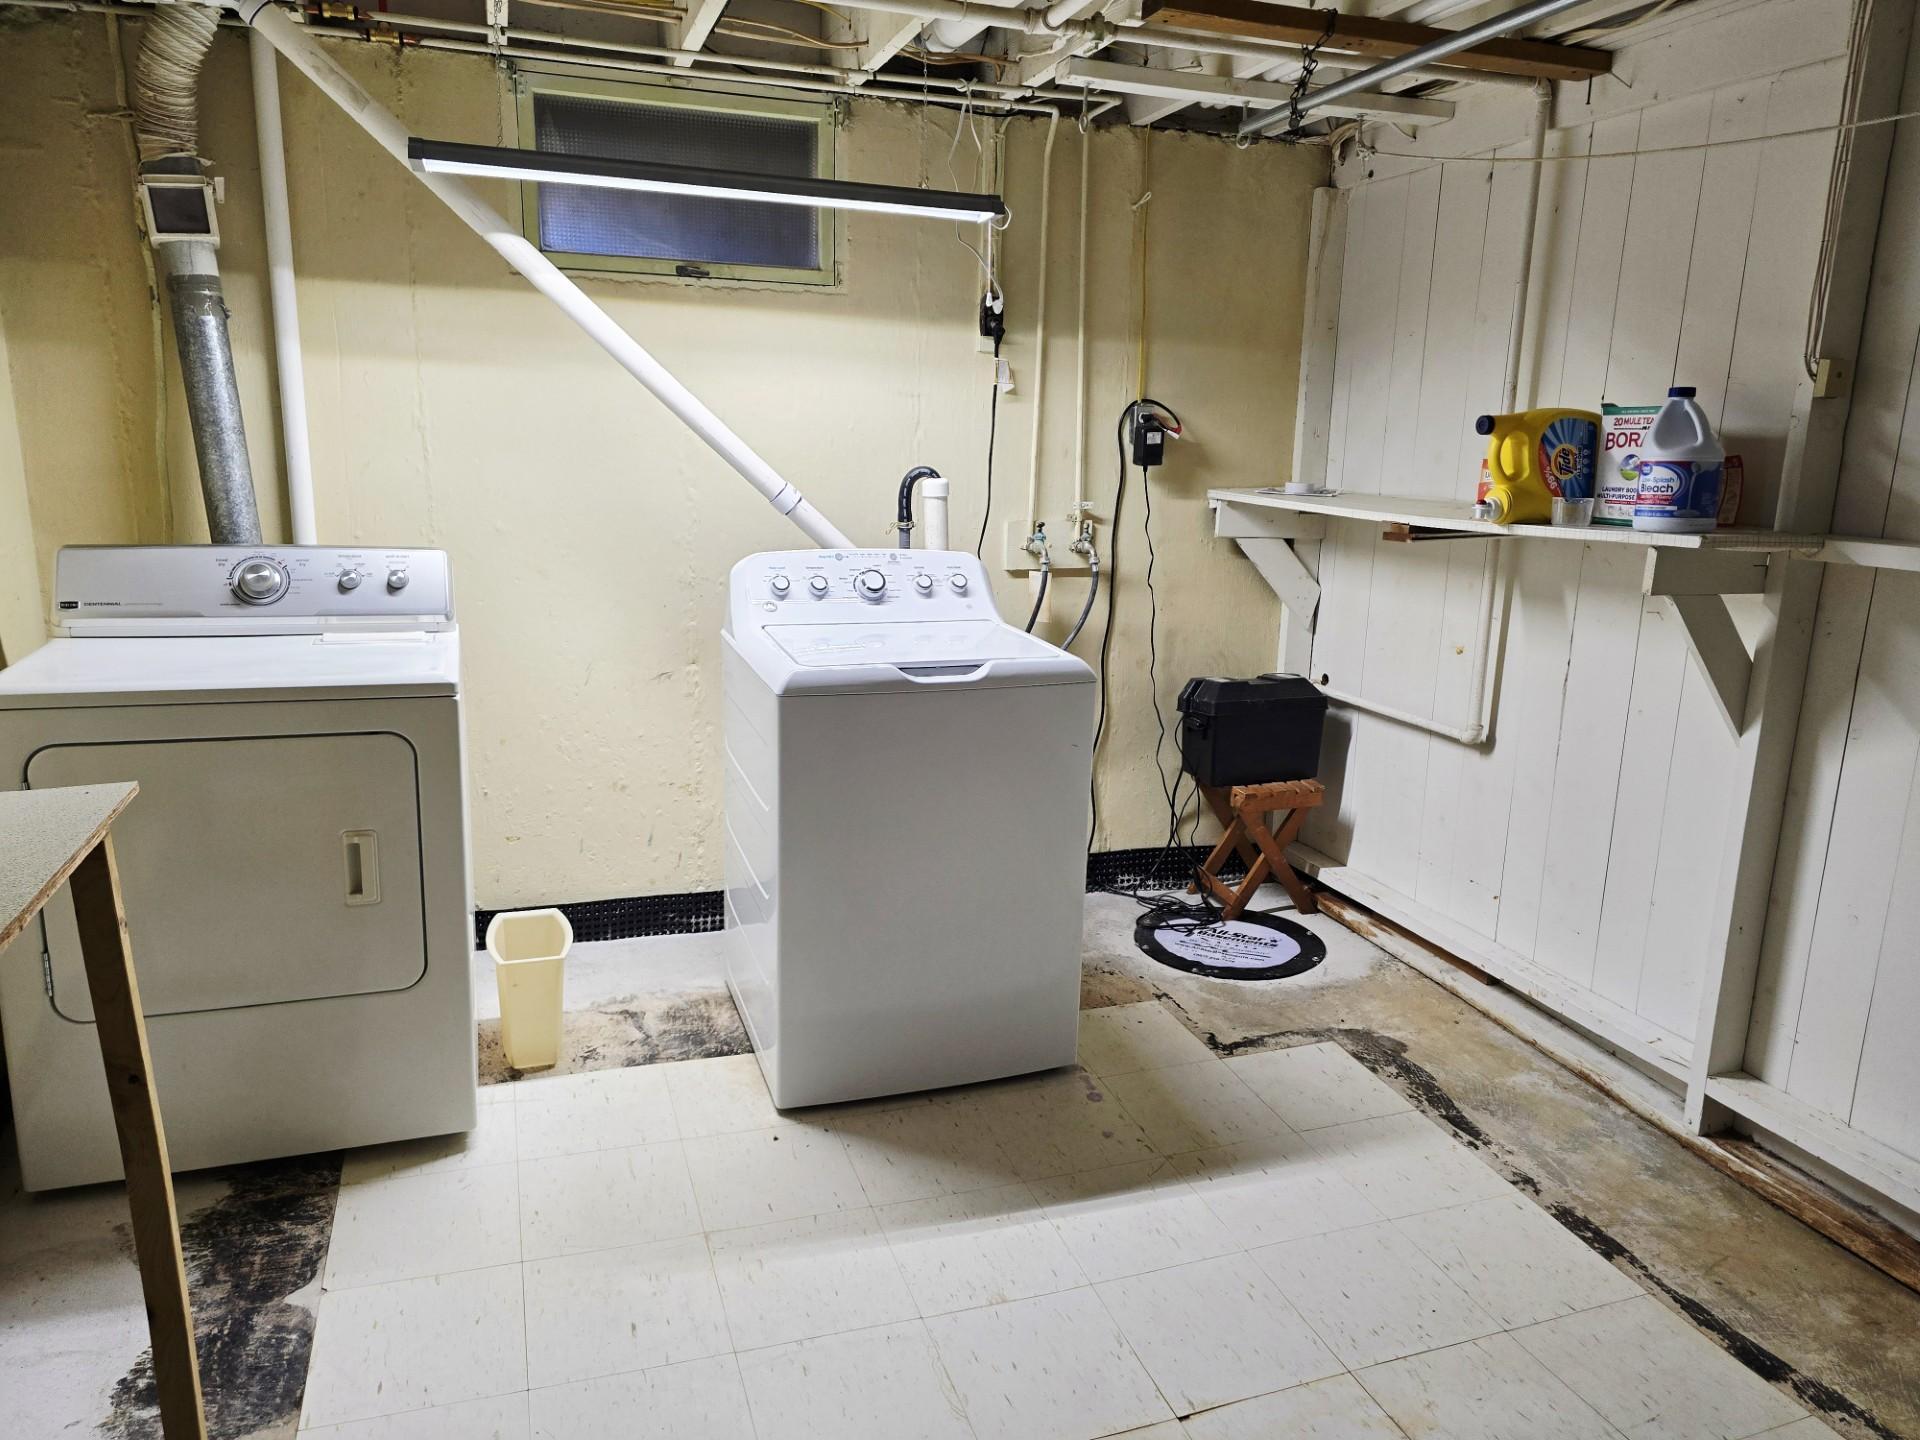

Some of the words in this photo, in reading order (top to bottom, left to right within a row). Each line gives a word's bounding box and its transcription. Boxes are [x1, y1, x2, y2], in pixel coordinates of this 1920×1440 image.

[1614, 417, 1623, 426] 20
[1624, 416, 1642, 425] MULE
[1642, 416, 1654, 425] TEA
[1605, 431, 1648, 452] BOR
[1558, 447, 1575, 475] Tide
[1641, 483, 1674, 493] Bleach
[1208, 928, 1267, 942] All-Star
